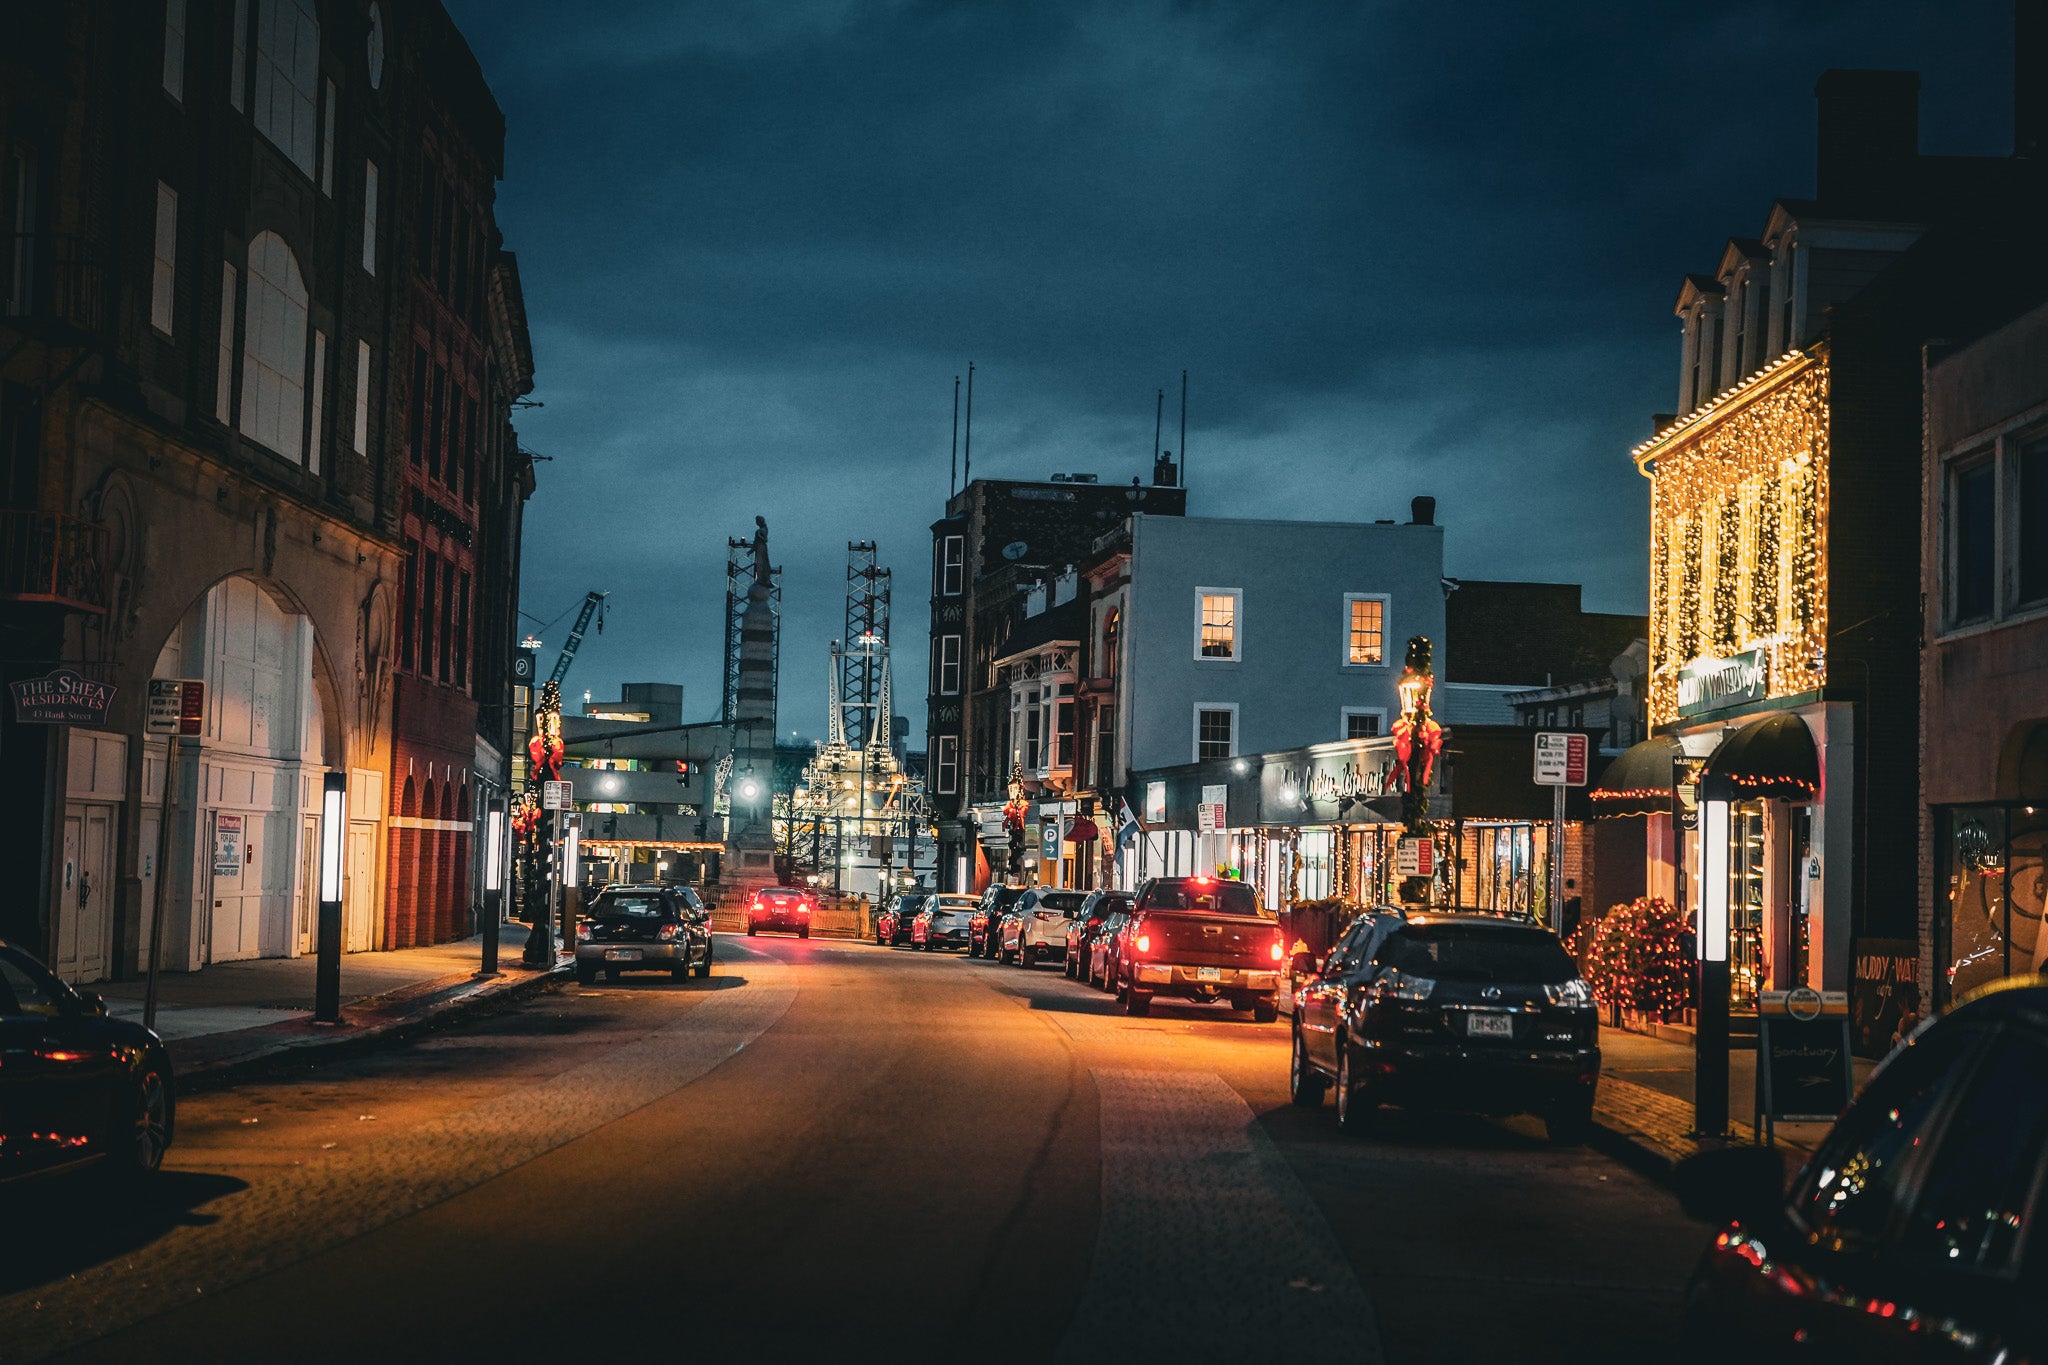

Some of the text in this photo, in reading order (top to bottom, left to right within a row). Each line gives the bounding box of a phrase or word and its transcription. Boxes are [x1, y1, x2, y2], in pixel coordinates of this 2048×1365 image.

[19, 676, 105, 700] THE SHEA
[1678, 674, 1706, 708] MUDDY
[1707, 664, 1742, 700] WATERS
[22, 694, 105, 710] RESIDENCES
[45, 710, 65, 719] Bank
[69, 712, 92, 721] Street
[1540, 737, 1547, 748] 2
[1855, 954, 1890, 981] MUDDY
[1773, 1043, 1840, 1068] Sanctuary
